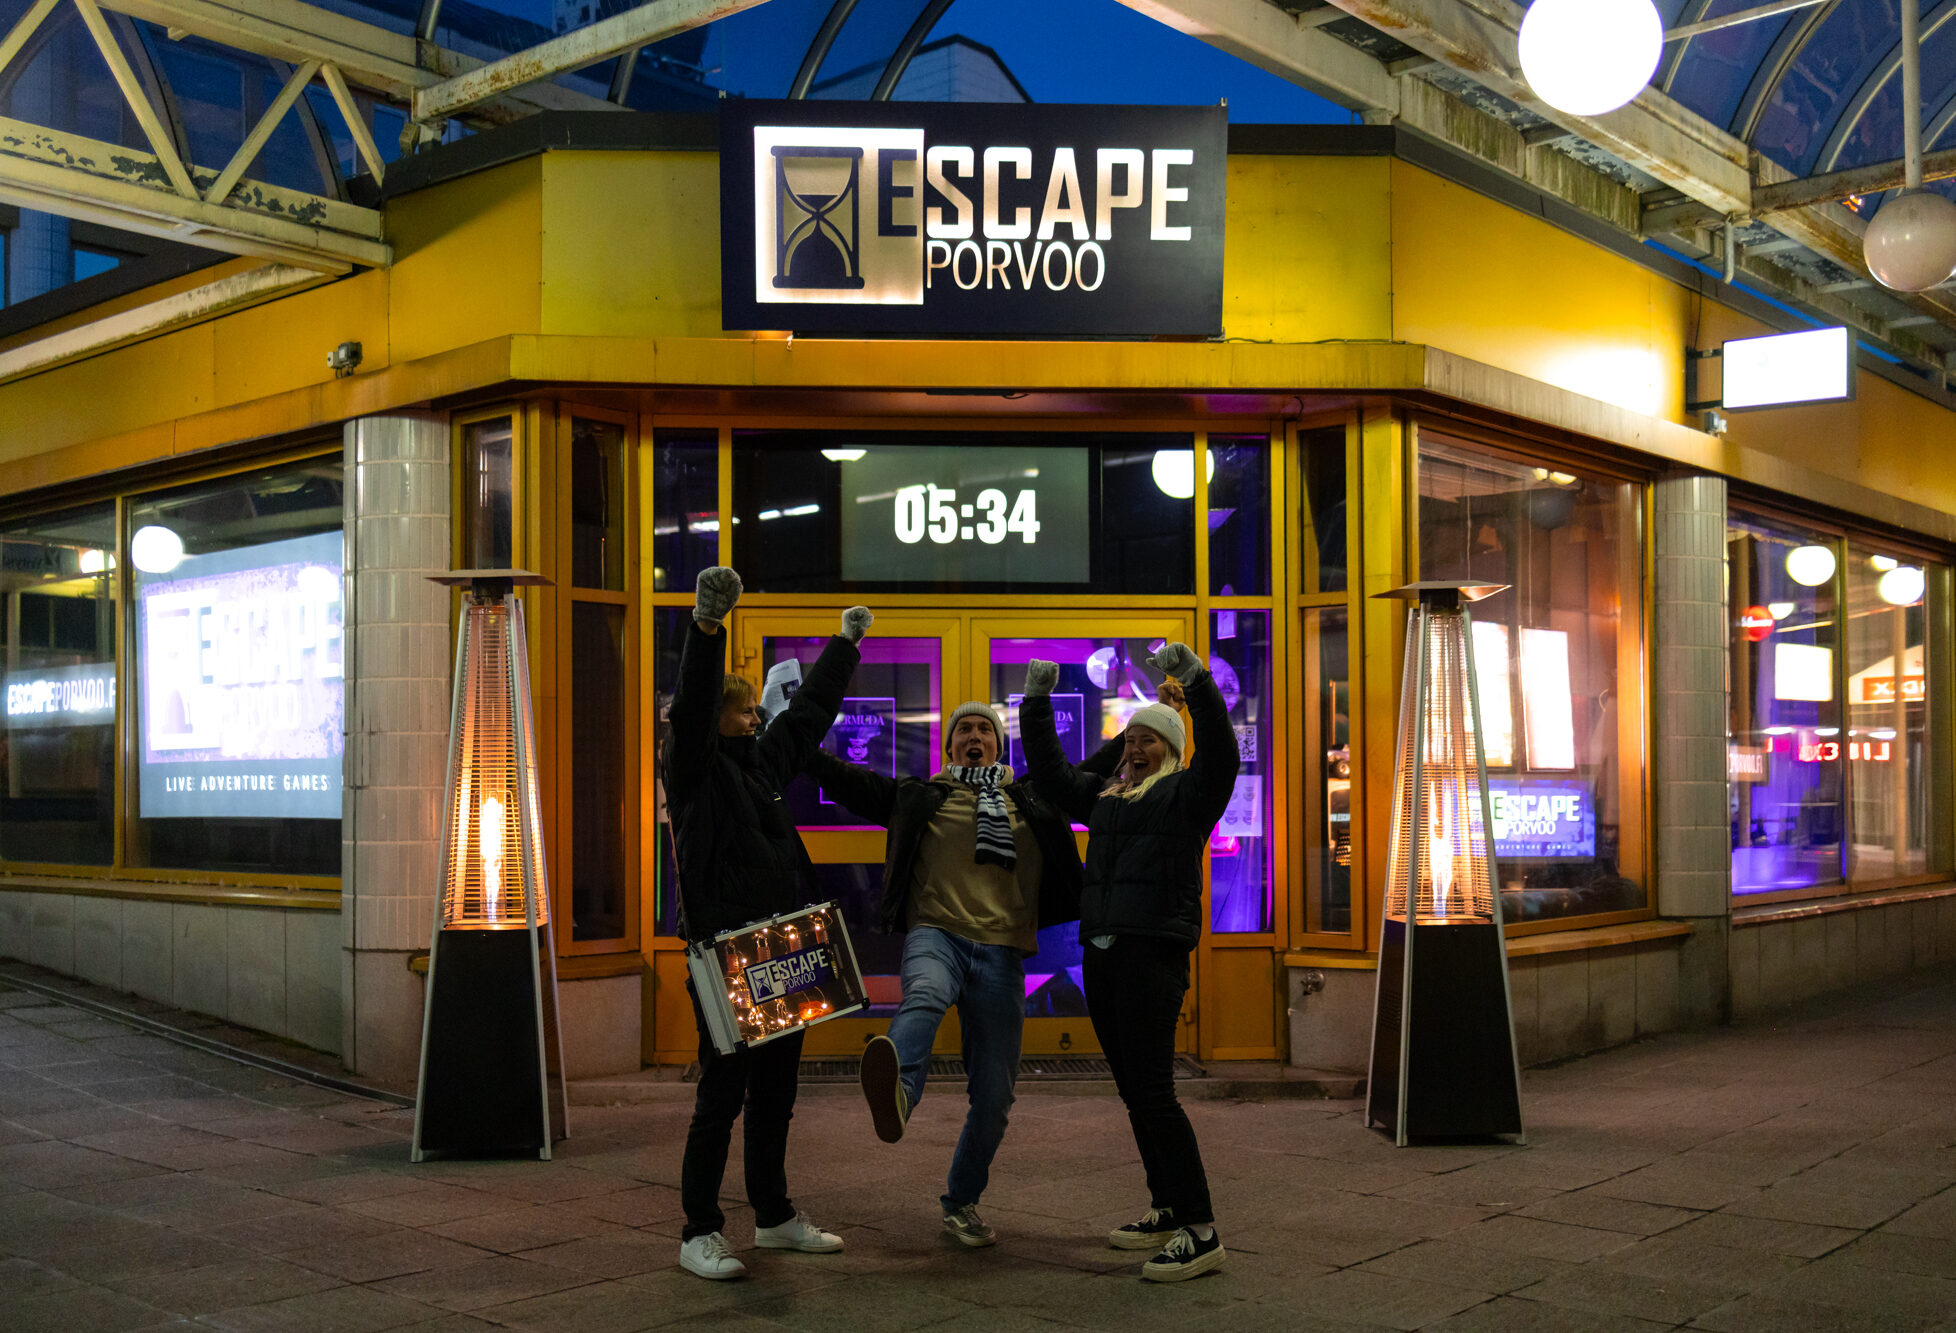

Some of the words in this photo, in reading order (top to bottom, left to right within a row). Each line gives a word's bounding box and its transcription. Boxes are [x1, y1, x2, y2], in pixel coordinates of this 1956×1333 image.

[877, 146, 1194, 240] ESCAPE
[926, 240, 1106, 292] PORVOO
[894, 485, 1041, 544] 05:34
[837, 714, 885, 727] ERMUDA
[166, 776, 193, 792] LIVE
[200, 775, 275, 792] ADVENTURE
[283, 774, 328, 792] GAMES
[1494, 795, 1580, 822] ESCAPE
[1508, 820, 1556, 835] PORVOO
[770, 948, 829, 982] ESCAPE
[783, 971, 816, 989] PORVOO
